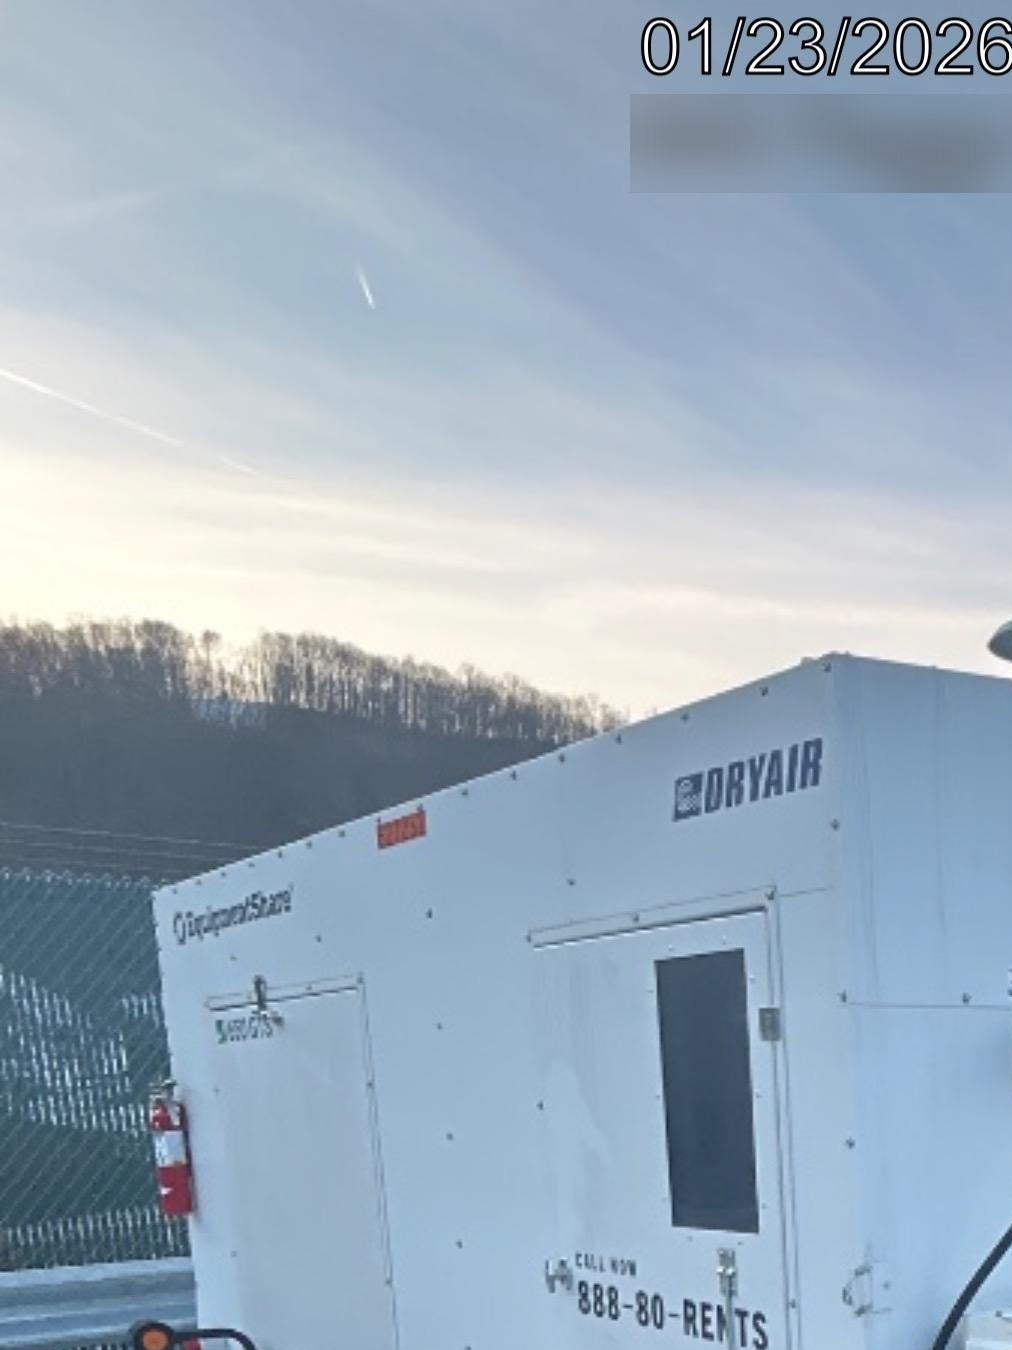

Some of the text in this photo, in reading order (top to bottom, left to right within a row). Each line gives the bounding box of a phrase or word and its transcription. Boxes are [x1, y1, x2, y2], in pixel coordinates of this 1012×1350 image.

[704, 737, 823, 814] DRYAIR
[575, 1253, 637, 1277] CALL NOW
